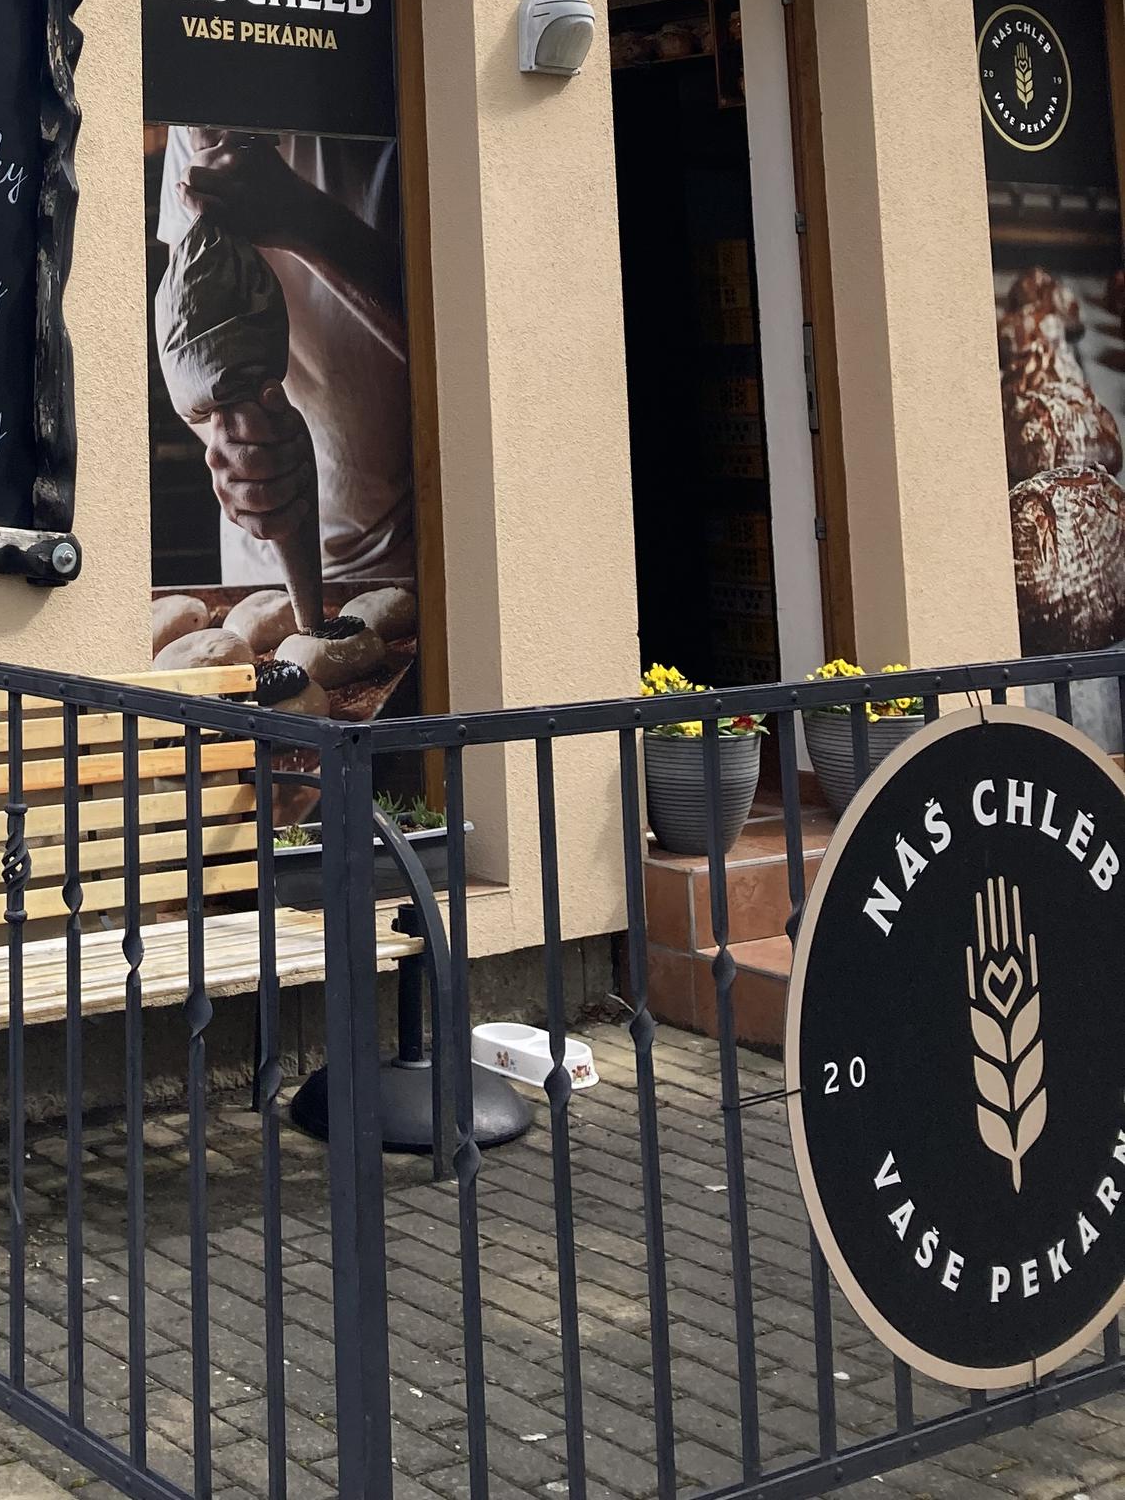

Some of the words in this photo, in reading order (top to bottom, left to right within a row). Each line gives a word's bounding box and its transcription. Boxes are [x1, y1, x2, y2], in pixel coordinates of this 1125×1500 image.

[181, 15, 235, 41] VAŠE
[240, 21, 338, 49] PEKÁRNA
[983, 69, 994, 79] 20
[862, 798, 953, 937] NÁŠ
[973, 778, 1120, 892] CHLÉB
[823, 1056, 867, 1095] 20
[874, 1151, 965, 1292] VAŠE
[990, 1084, 1125, 1303] PEKÁR
